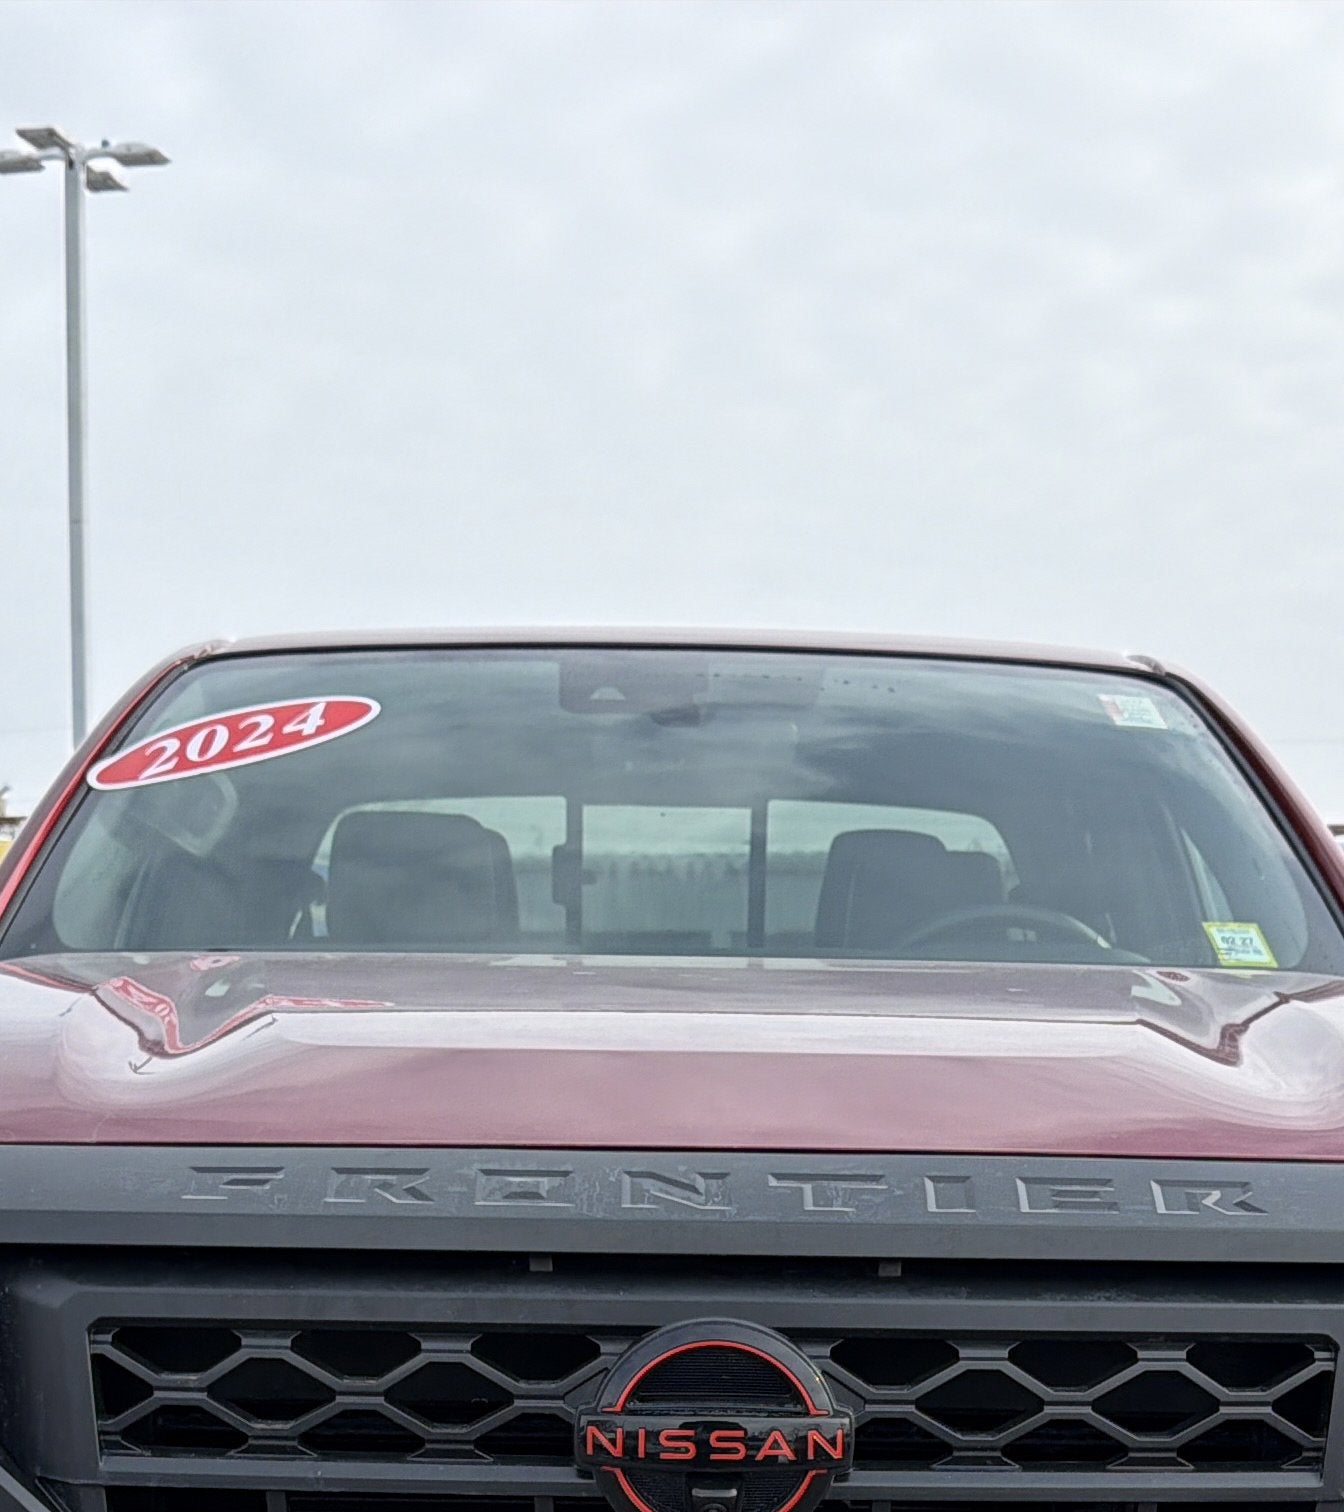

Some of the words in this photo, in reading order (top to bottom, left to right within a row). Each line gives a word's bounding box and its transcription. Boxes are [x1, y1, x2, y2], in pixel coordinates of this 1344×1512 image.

[136, 701, 327, 781] 2024
[181, 1166, 1270, 1216] FRONTIER
[585, 1425, 845, 1461] NISSAN
